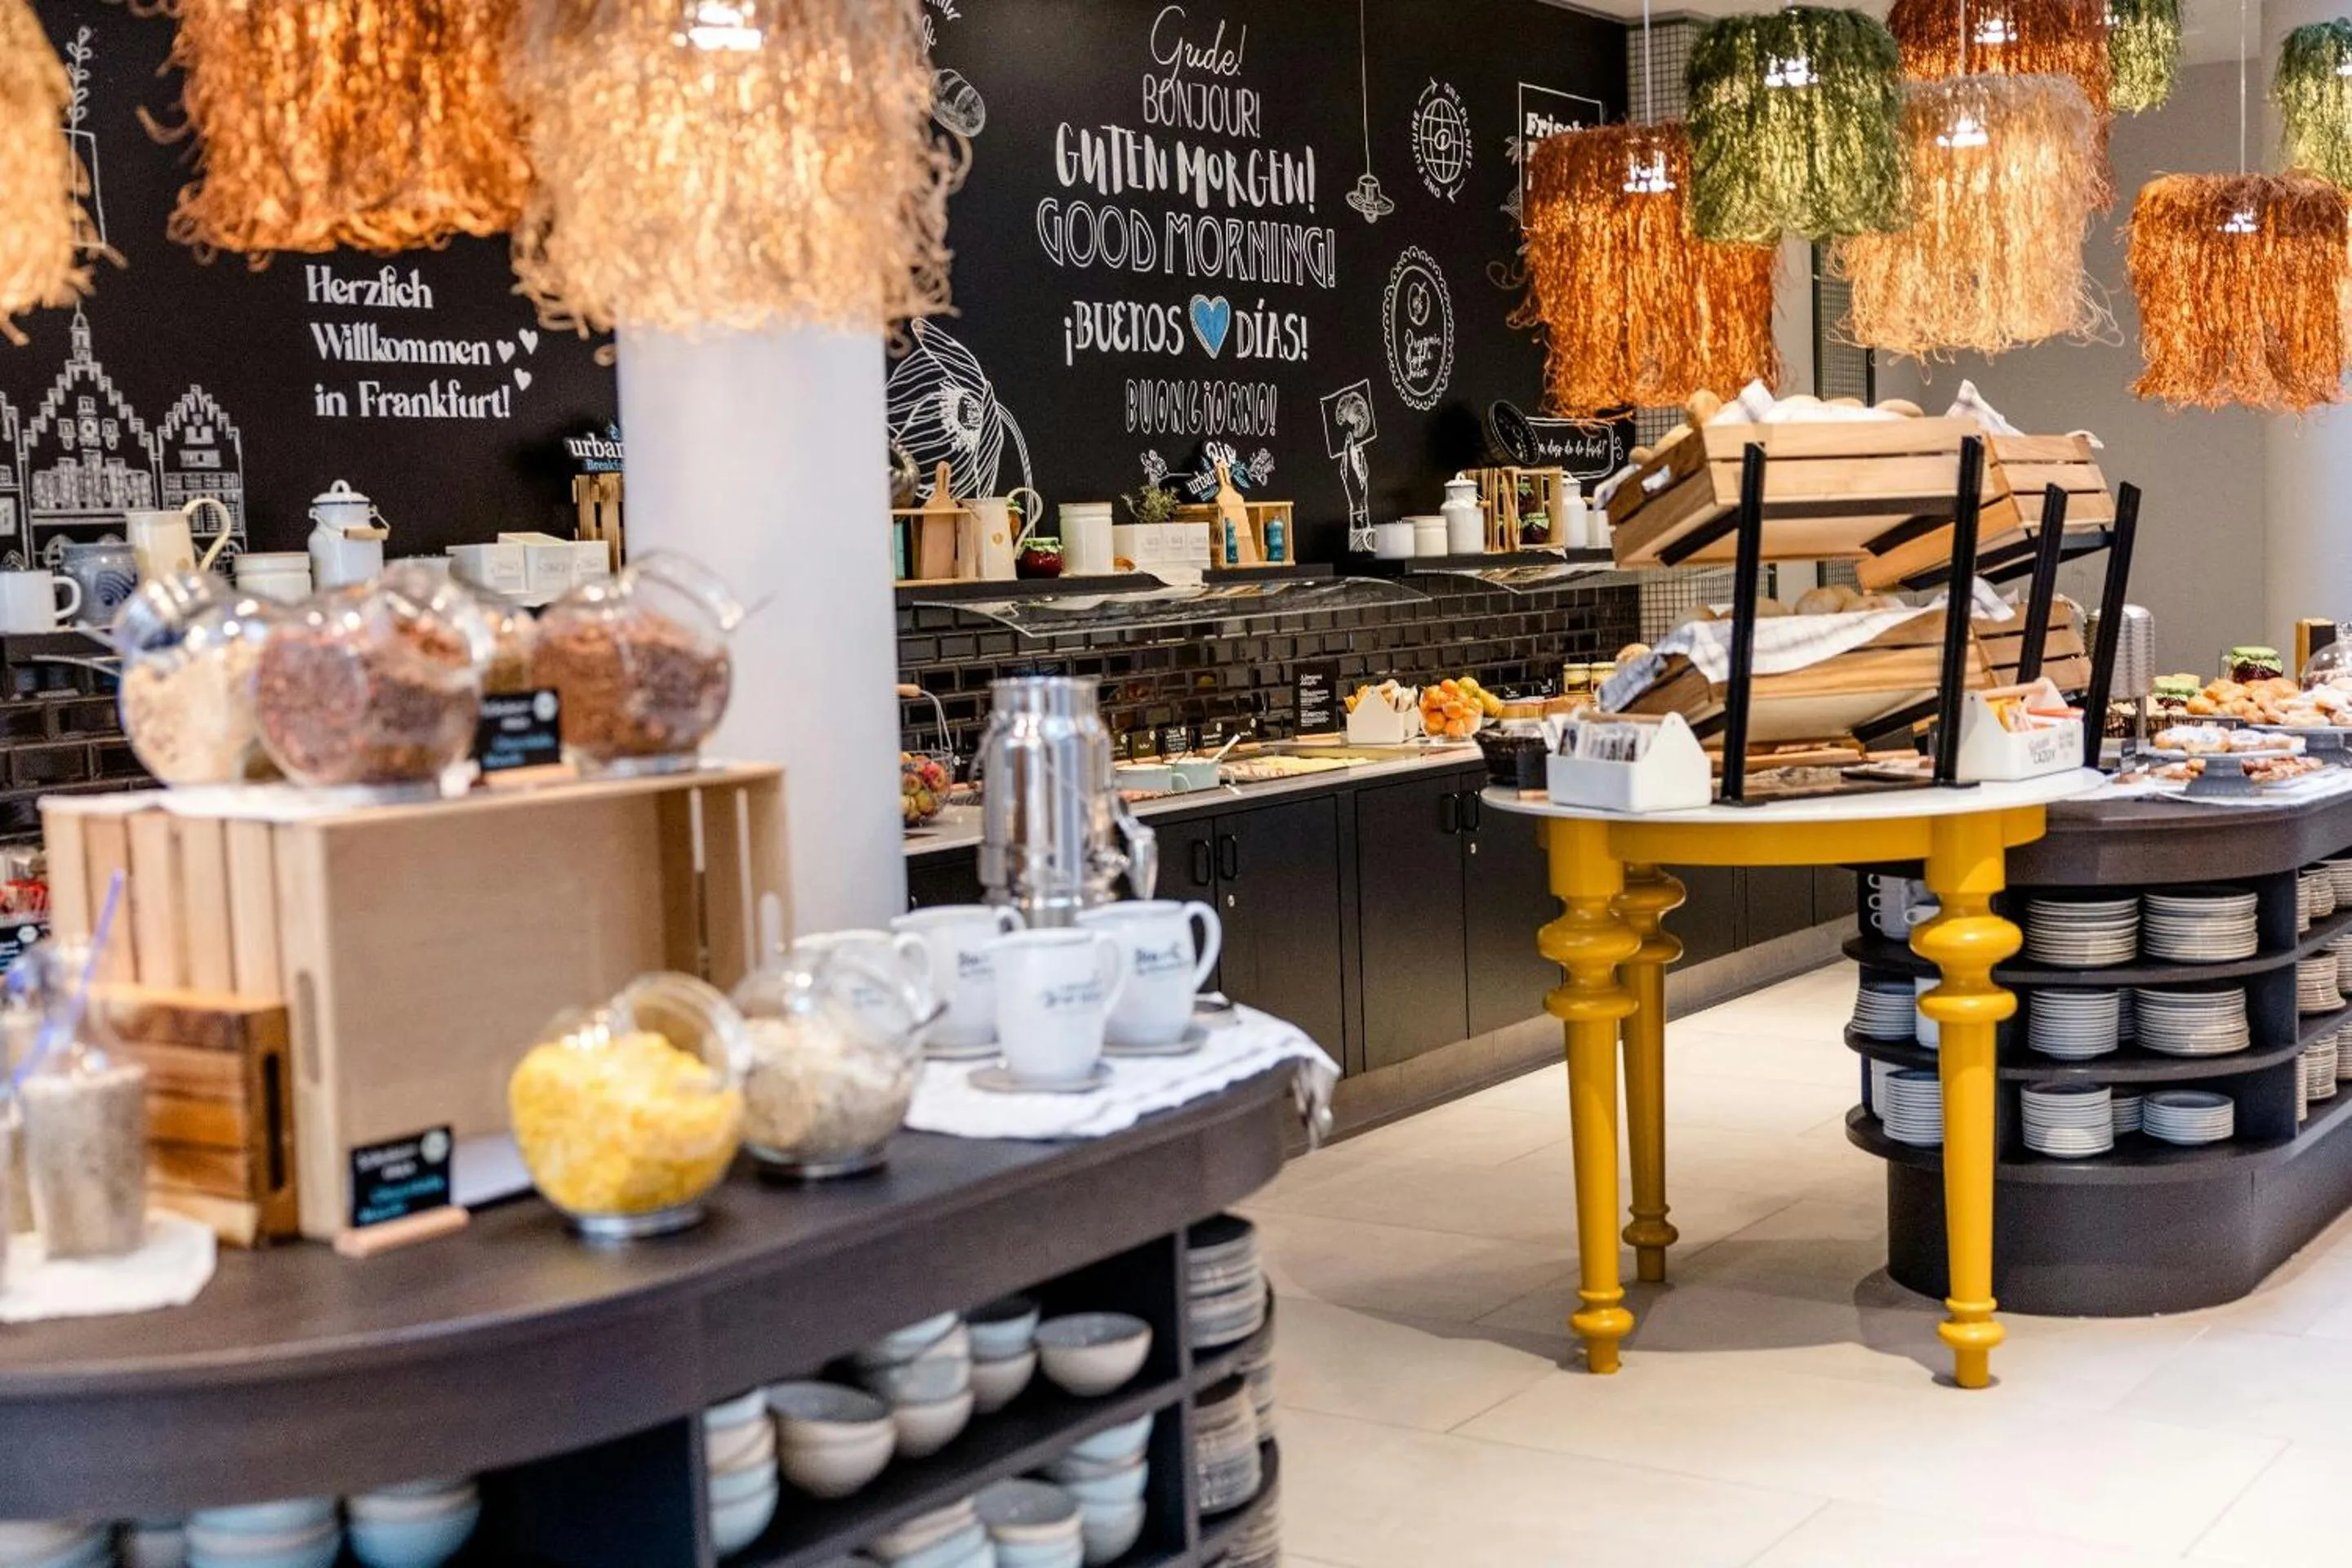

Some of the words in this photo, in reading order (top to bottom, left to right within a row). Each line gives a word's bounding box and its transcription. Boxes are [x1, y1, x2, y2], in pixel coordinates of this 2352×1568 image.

[1150, 5, 1247, 94] Gude!
[1143, 73, 1262, 139] BONJOUR!
[1055, 122, 1168, 197] GUTEN
[1175, 136, 1316, 215] MORGEN!
[1036, 196, 1157, 273] GOOD
[1164, 211, 1336, 289] MORNING!
[305, 264, 434, 310] Herzlich
[309, 321, 492, 367] Willkommen
[1234, 297, 1308, 362] DÍAS!
[314, 382, 349, 417] in
[357, 377, 511, 419] Frankfurt!
